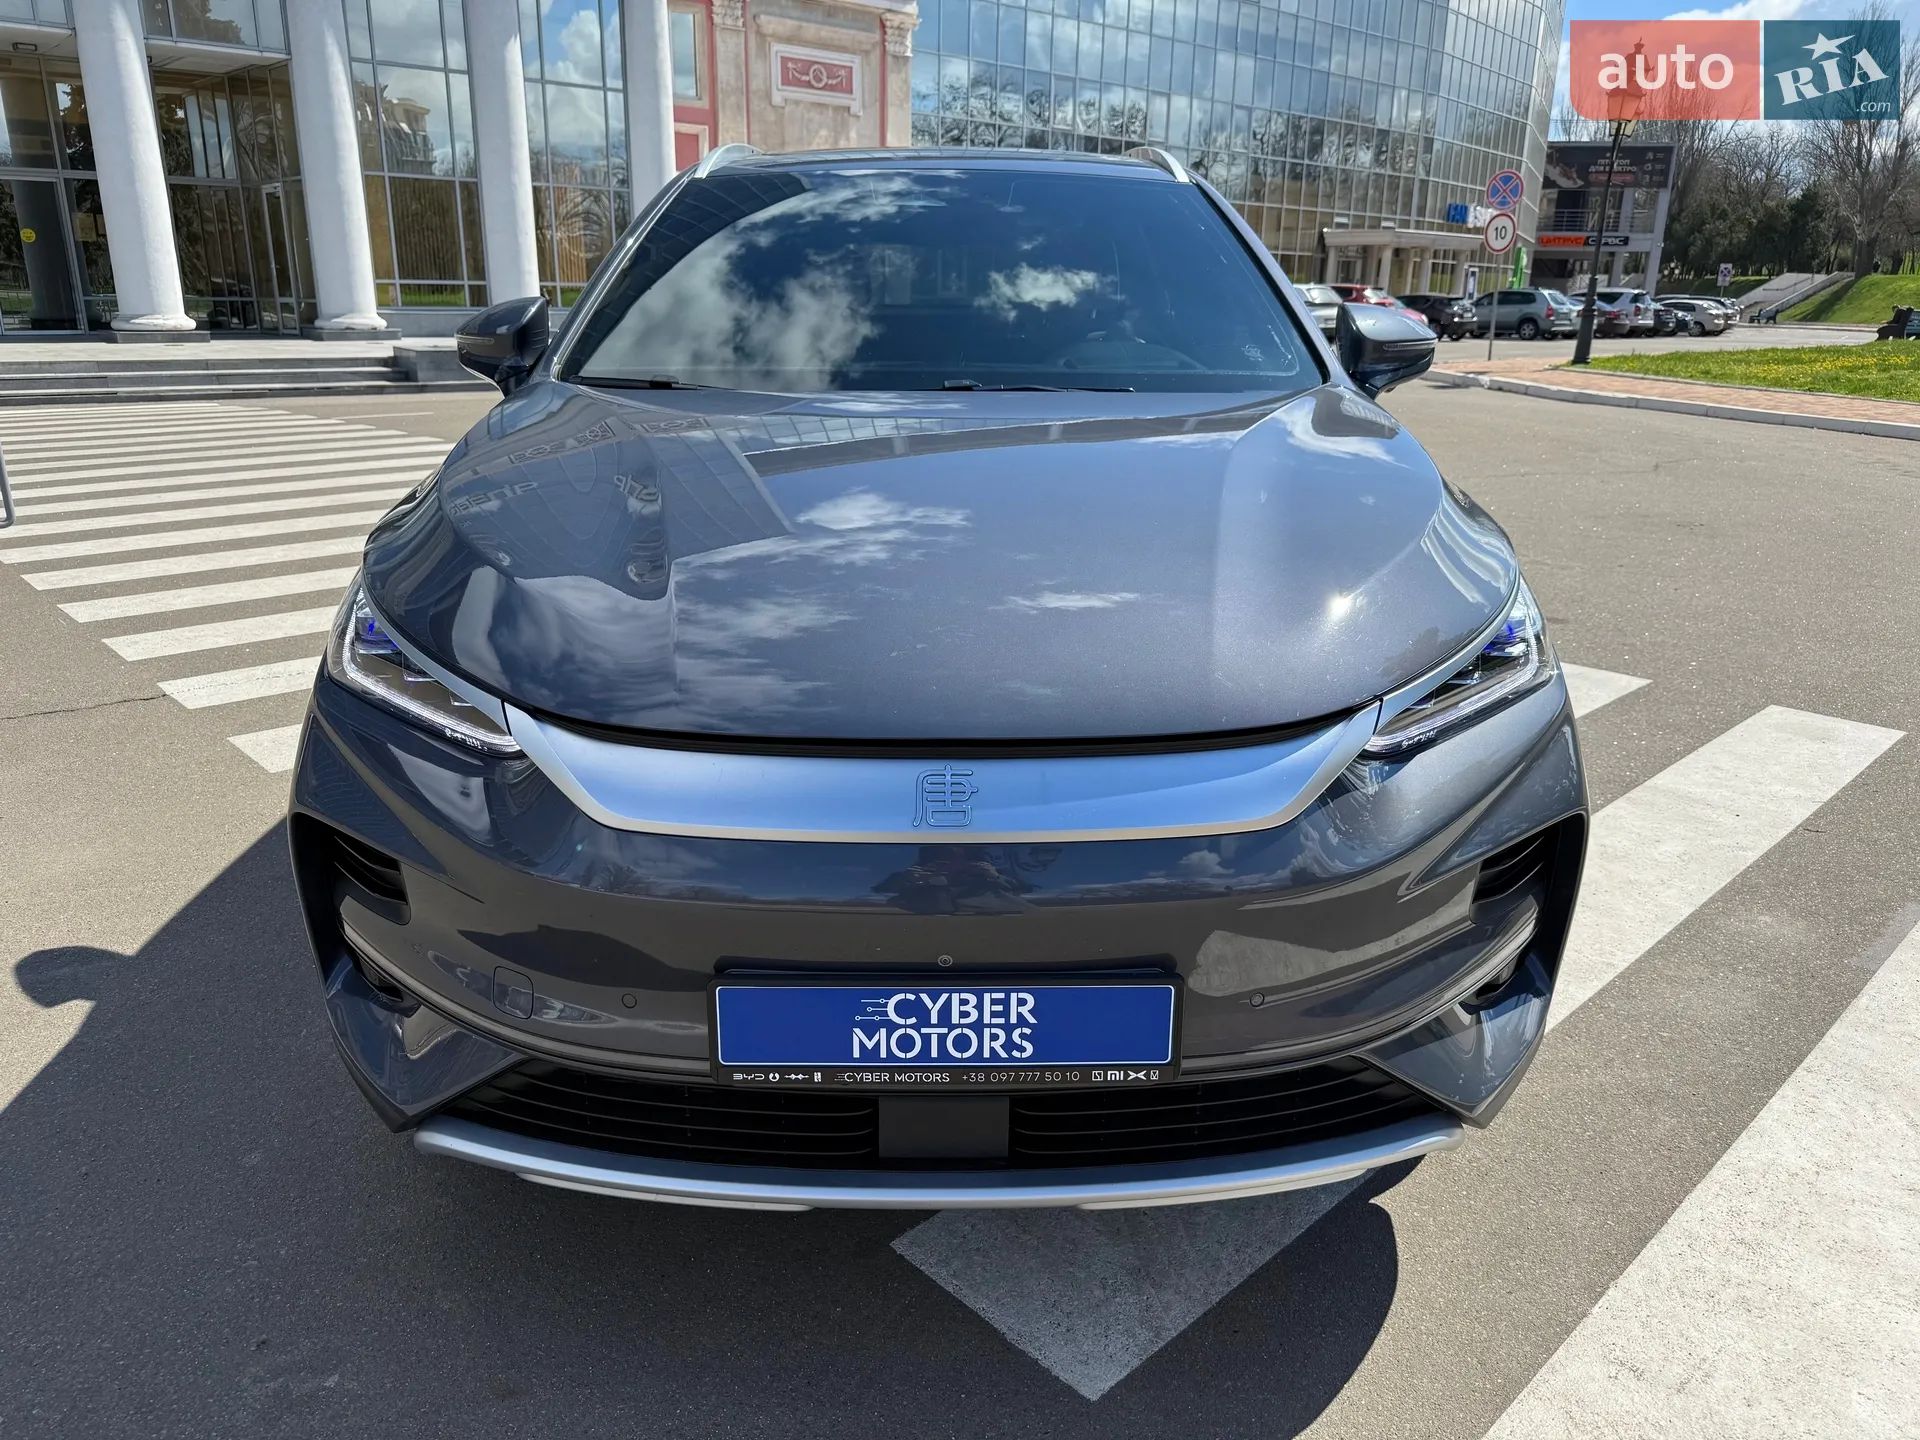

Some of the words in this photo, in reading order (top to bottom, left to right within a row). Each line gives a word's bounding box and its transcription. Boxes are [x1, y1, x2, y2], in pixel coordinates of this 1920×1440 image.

[1494, 226, 1508, 241] 10
[1588, 237, 1625, 245] СРВІС
[886, 992, 1038, 1025] CYBER
[852, 1027, 1034, 1059] MOTORS
[844, 1072, 890, 1083] CYBER
[894, 1072, 950, 1083] MOTORS
[962, 1072, 985, 1082] +38
[990, 1072, 1015, 1082] 097
[1018, 1072, 1041, 1081] 777
[1045, 1071, 1062, 1081] 50
[1065, 1071, 1080, 1081] 10
